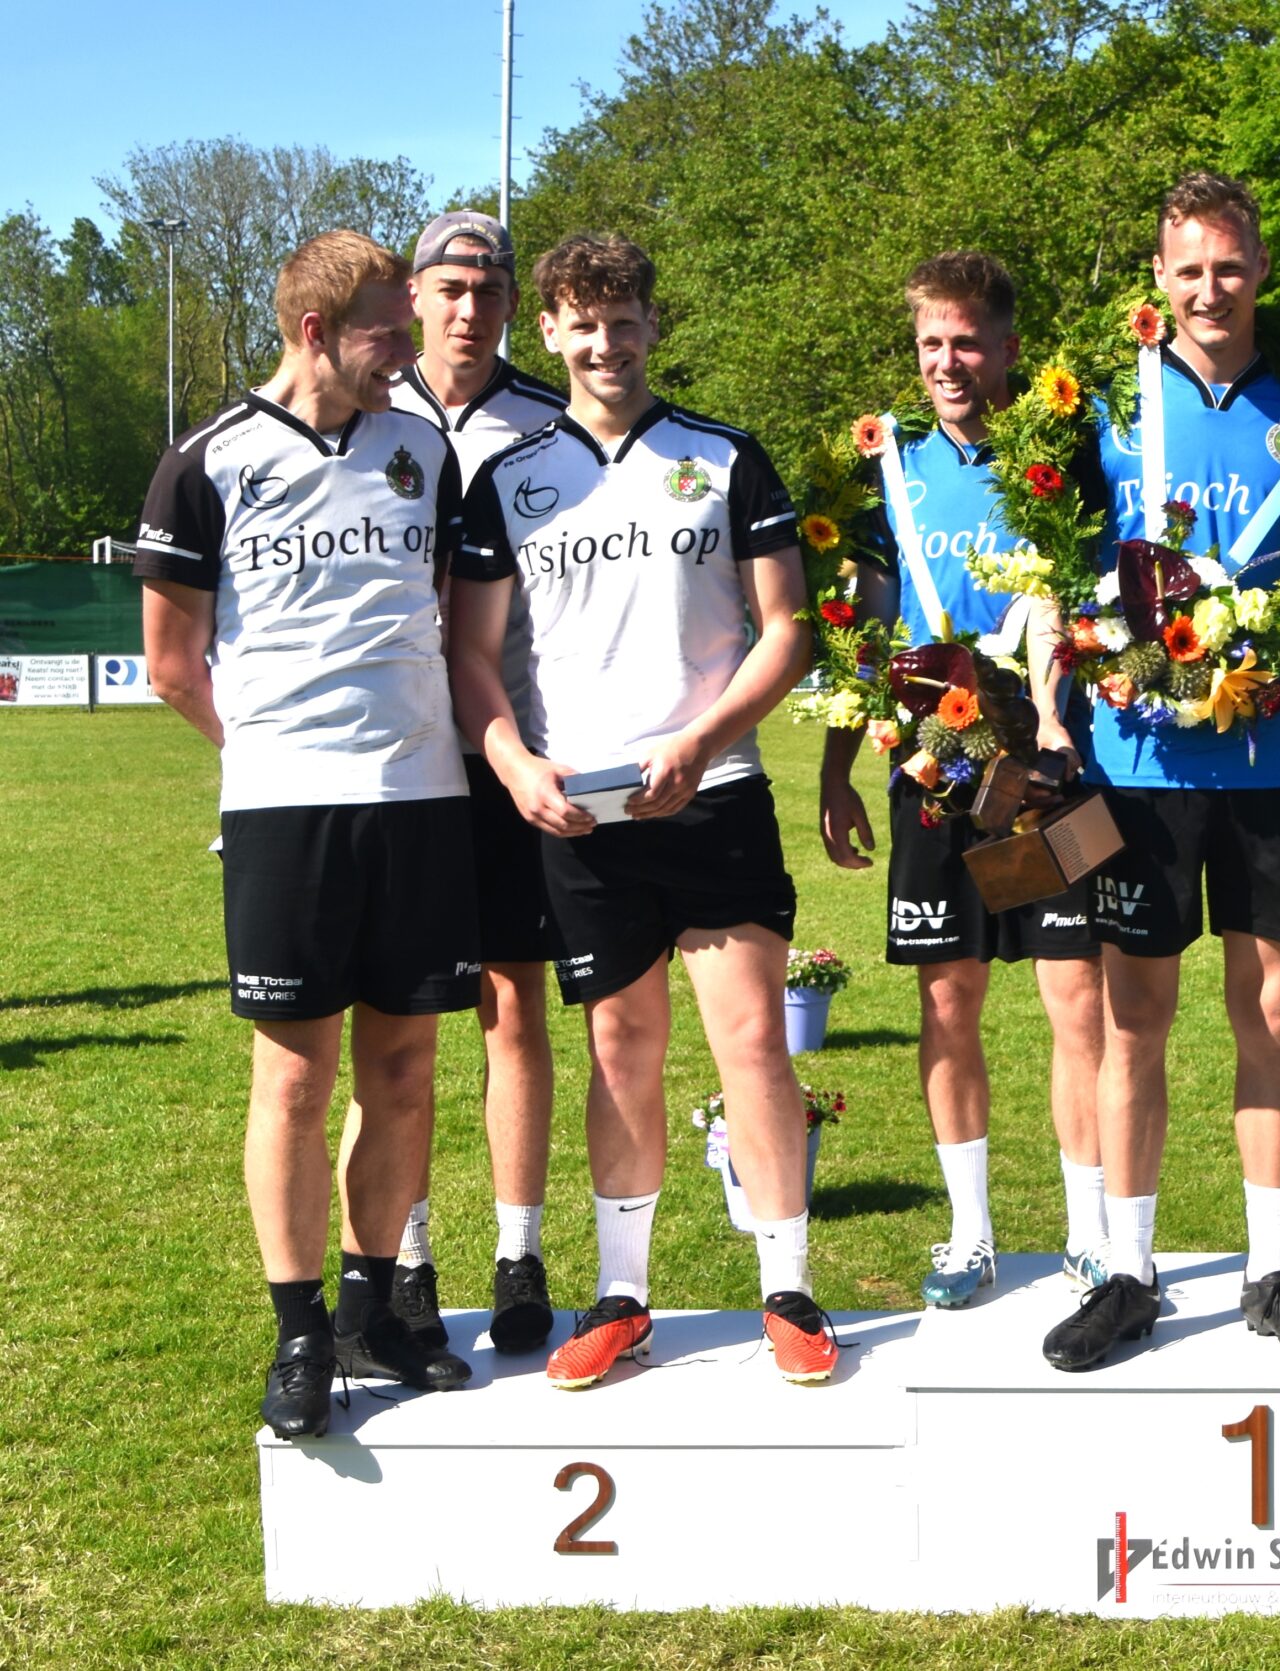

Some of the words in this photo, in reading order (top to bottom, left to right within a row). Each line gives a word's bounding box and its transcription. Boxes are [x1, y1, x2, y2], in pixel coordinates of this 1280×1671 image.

[240, 517, 389, 574] Tsjoch
[518, 521, 652, 579] Tsjoch
[670, 526, 719, 565] op
[252, 991, 267, 1000] DE
[267, 992, 297, 1001] VRIES
[260, 976, 303, 987] Totaal
[1222, 1405, 1270, 1527] 1
[554, 1462, 616, 1554] 2
[1152, 1537, 1255, 1570] Edwin
